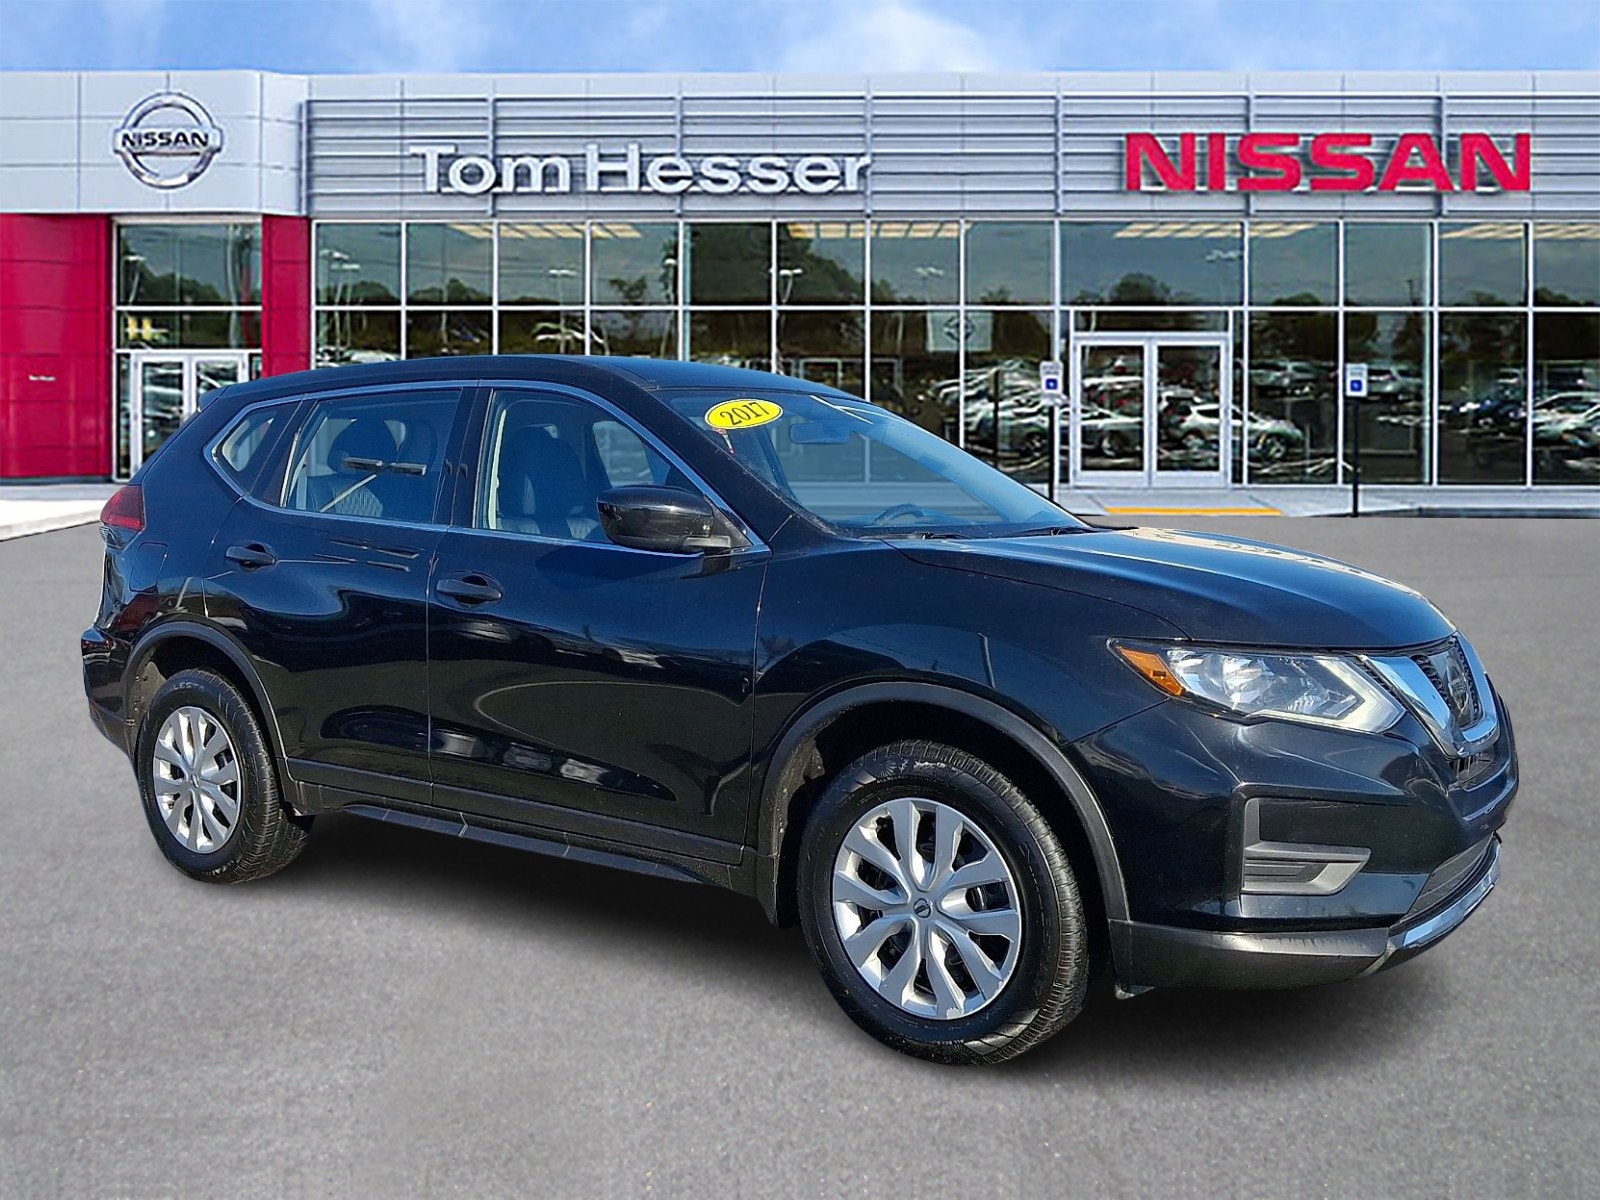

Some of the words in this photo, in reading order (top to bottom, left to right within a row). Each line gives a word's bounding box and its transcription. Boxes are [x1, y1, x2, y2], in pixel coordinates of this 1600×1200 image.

[121, 131, 209, 148] NISSAN
[409, 143, 571, 194] Tom
[585, 142, 872, 193] Hesser
[1125, 132, 1532, 192] NISSAN
[719, 401, 770, 426] 2017
